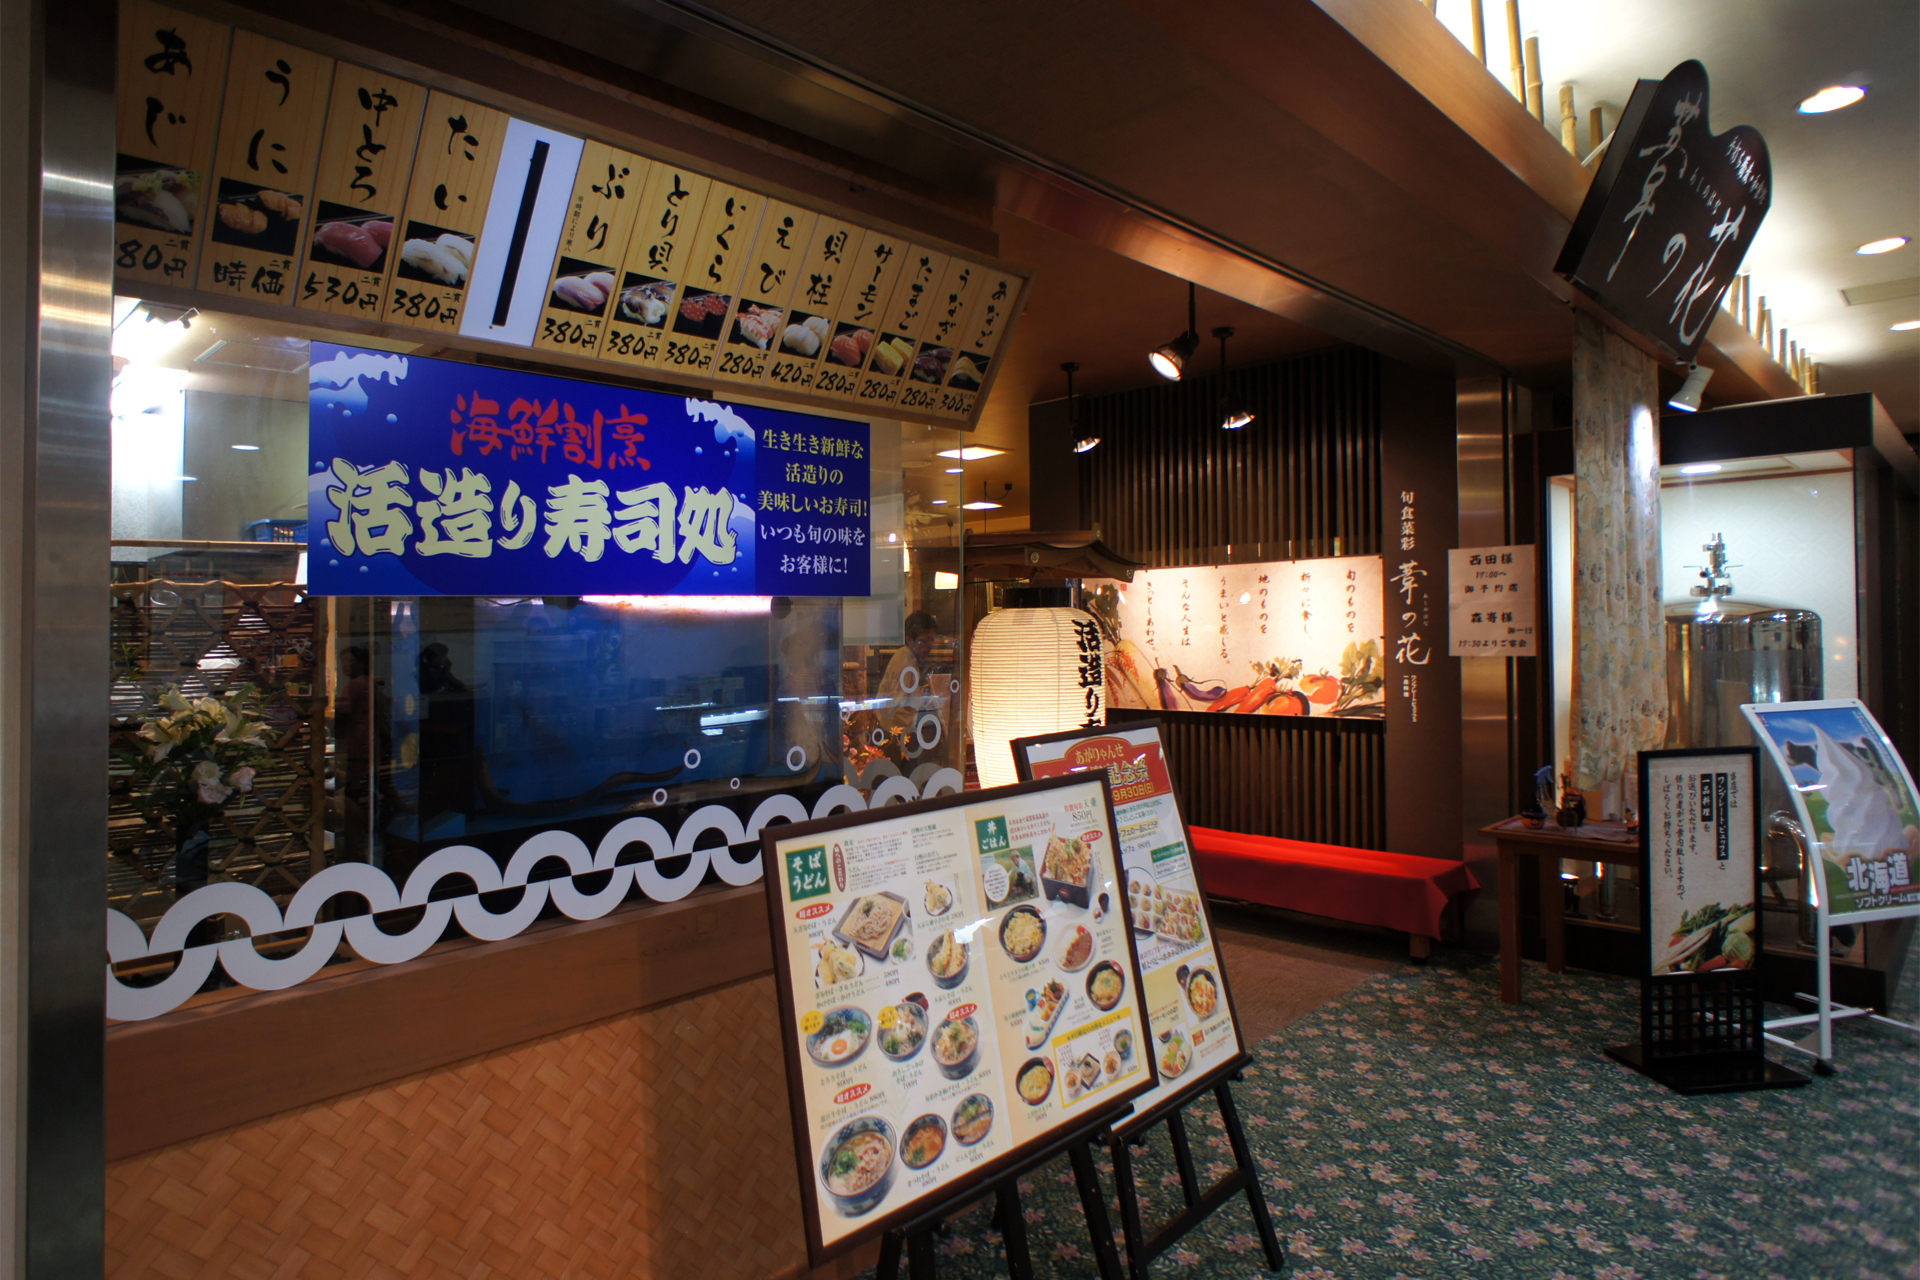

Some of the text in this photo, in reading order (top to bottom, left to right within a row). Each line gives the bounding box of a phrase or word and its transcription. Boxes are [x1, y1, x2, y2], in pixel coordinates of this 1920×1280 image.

[145, 27, 193, 147] あじ
[247, 59, 292, 174] うに
[350, 88, 398, 202] 中とろ
[434, 114, 479, 210] たい
[586, 163, 630, 253] ぶり
[648, 173, 690, 273] とり貝
[165, 239, 191, 251] 二貫
[708, 197, 747, 285] いくら
[759, 216, 794, 294] えび
[214, 261, 284, 295] 時価
[269, 259, 293, 271] 二貫
[303, 272, 378, 311] 530円
[361, 276, 382, 287] 二貫
[854, 243, 893, 321] サーモン
[898, 256, 933, 330] たまご
[392, 288, 457, 325] 380円
[442, 292, 463, 303] 二貫
[935, 268, 970, 341] うなぎ
[975, 281, 1008, 349] あなご
[541, 317, 598, 349] 380円
[607, 331, 659, 361] 380円
[664, 341, 712, 370] 380円
[718, 352, 765, 379] 280円
[770, 361, 814, 388] 420円
[816, 371, 855, 395] 280円
[860, 379, 897, 403] 280円
[901, 387, 936, 410] 280円
[939, 394, 972, 416] 300円
[449, 390, 651, 471] 海鮮割烹
[762, 429, 864, 460] 生き生き新鮮な
[785, 462, 844, 486] 活造りの
[327, 457, 738, 566] 活造り寿司処
[760, 524, 866, 546] いつも旬の味を
[1469, 553, 1513, 566] 西田様
[1071, 619, 1103, 727] 活造り
[982, 836, 1008, 850] ごはん
[792, 851, 823, 873] そば
[1846, 852, 1910, 895] 北海道
[792, 872, 827, 895] うどん
[1856, 893, 1908, 909] ソフトクリーム
